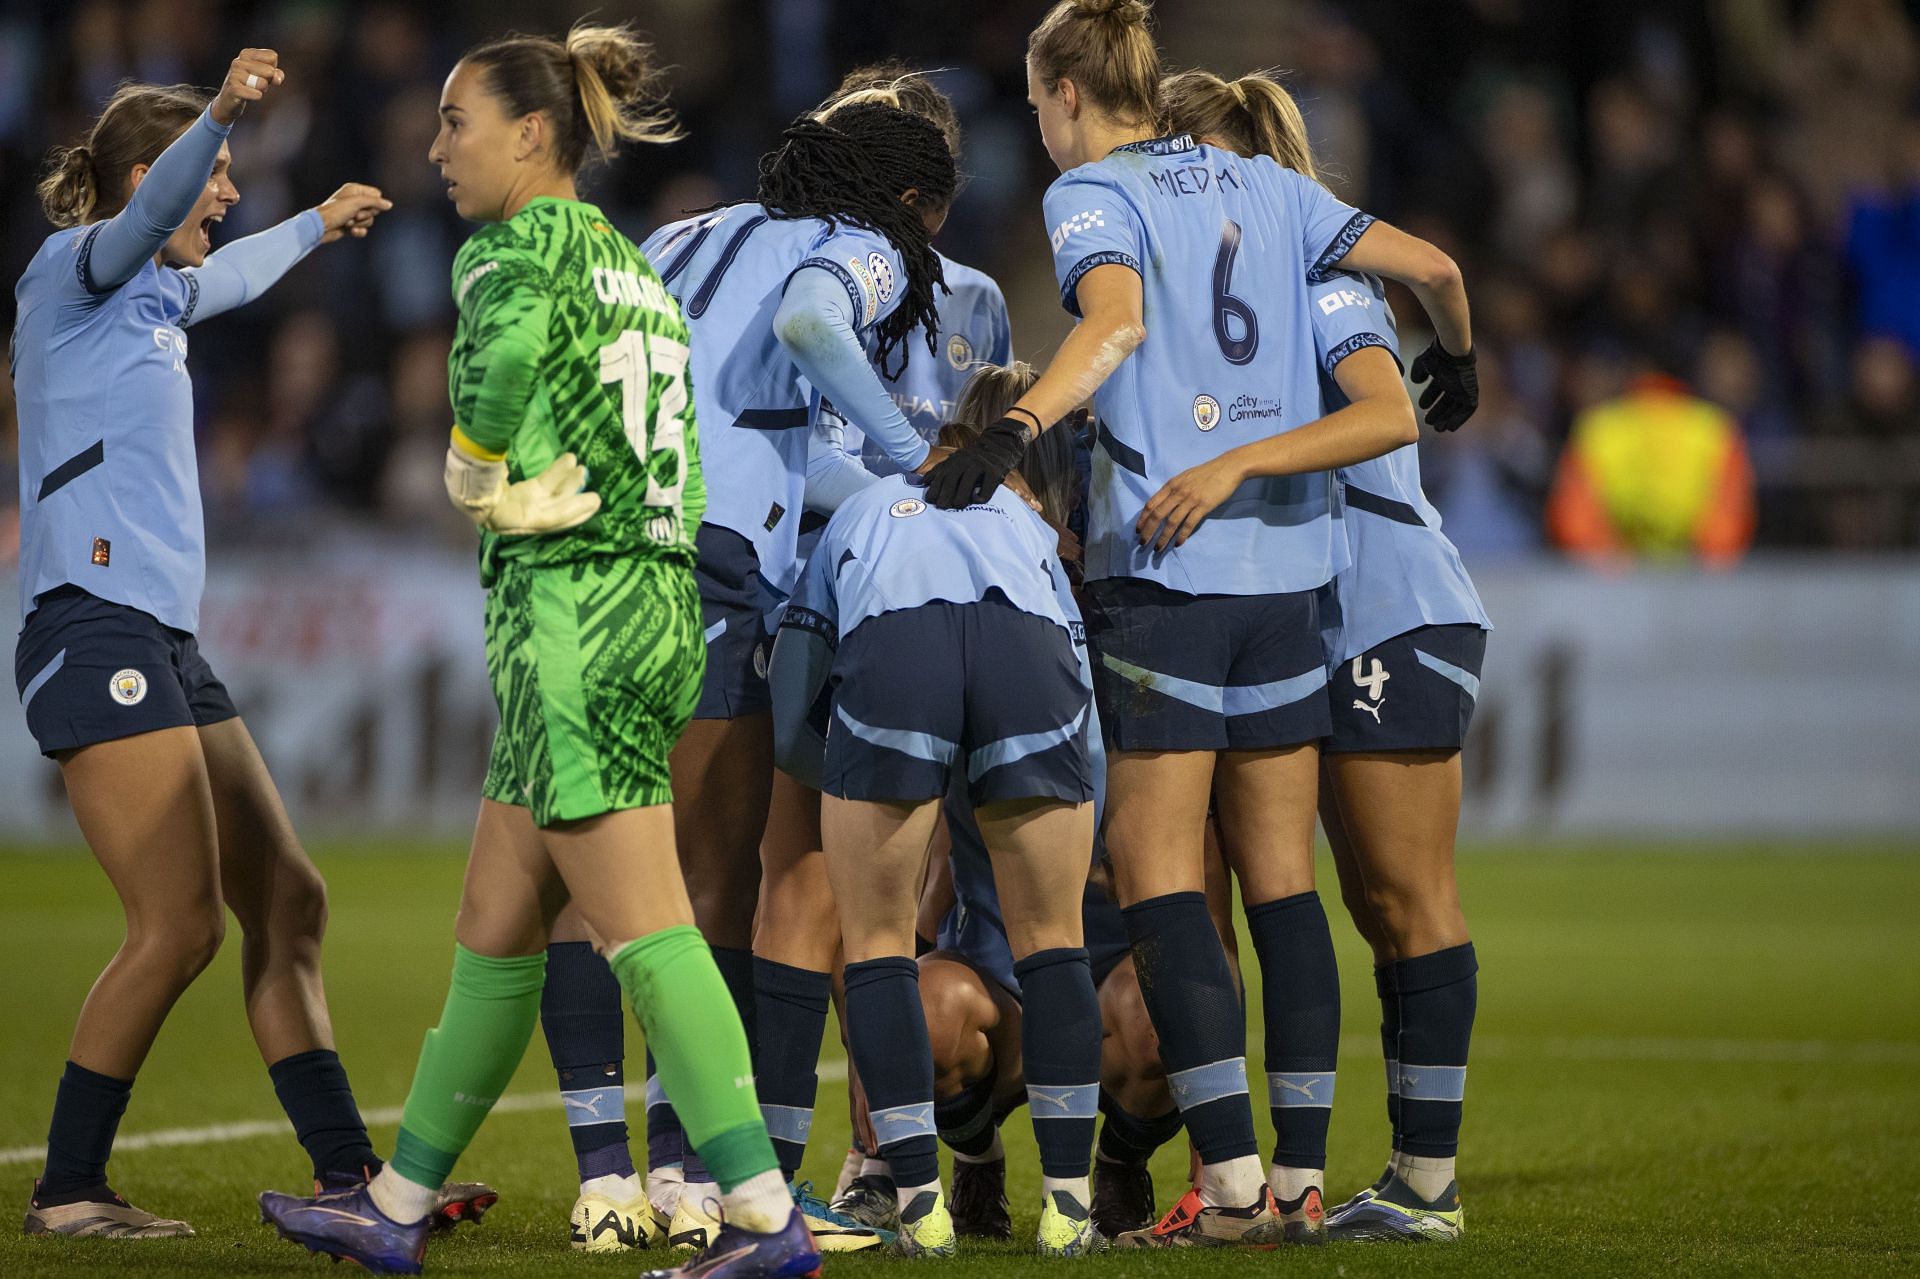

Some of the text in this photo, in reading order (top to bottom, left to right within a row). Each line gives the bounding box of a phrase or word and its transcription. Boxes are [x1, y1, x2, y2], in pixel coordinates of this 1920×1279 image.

[1211, 218, 1259, 366] 6
[599, 329, 691, 507] 13
[1352, 655, 1390, 700] 4
